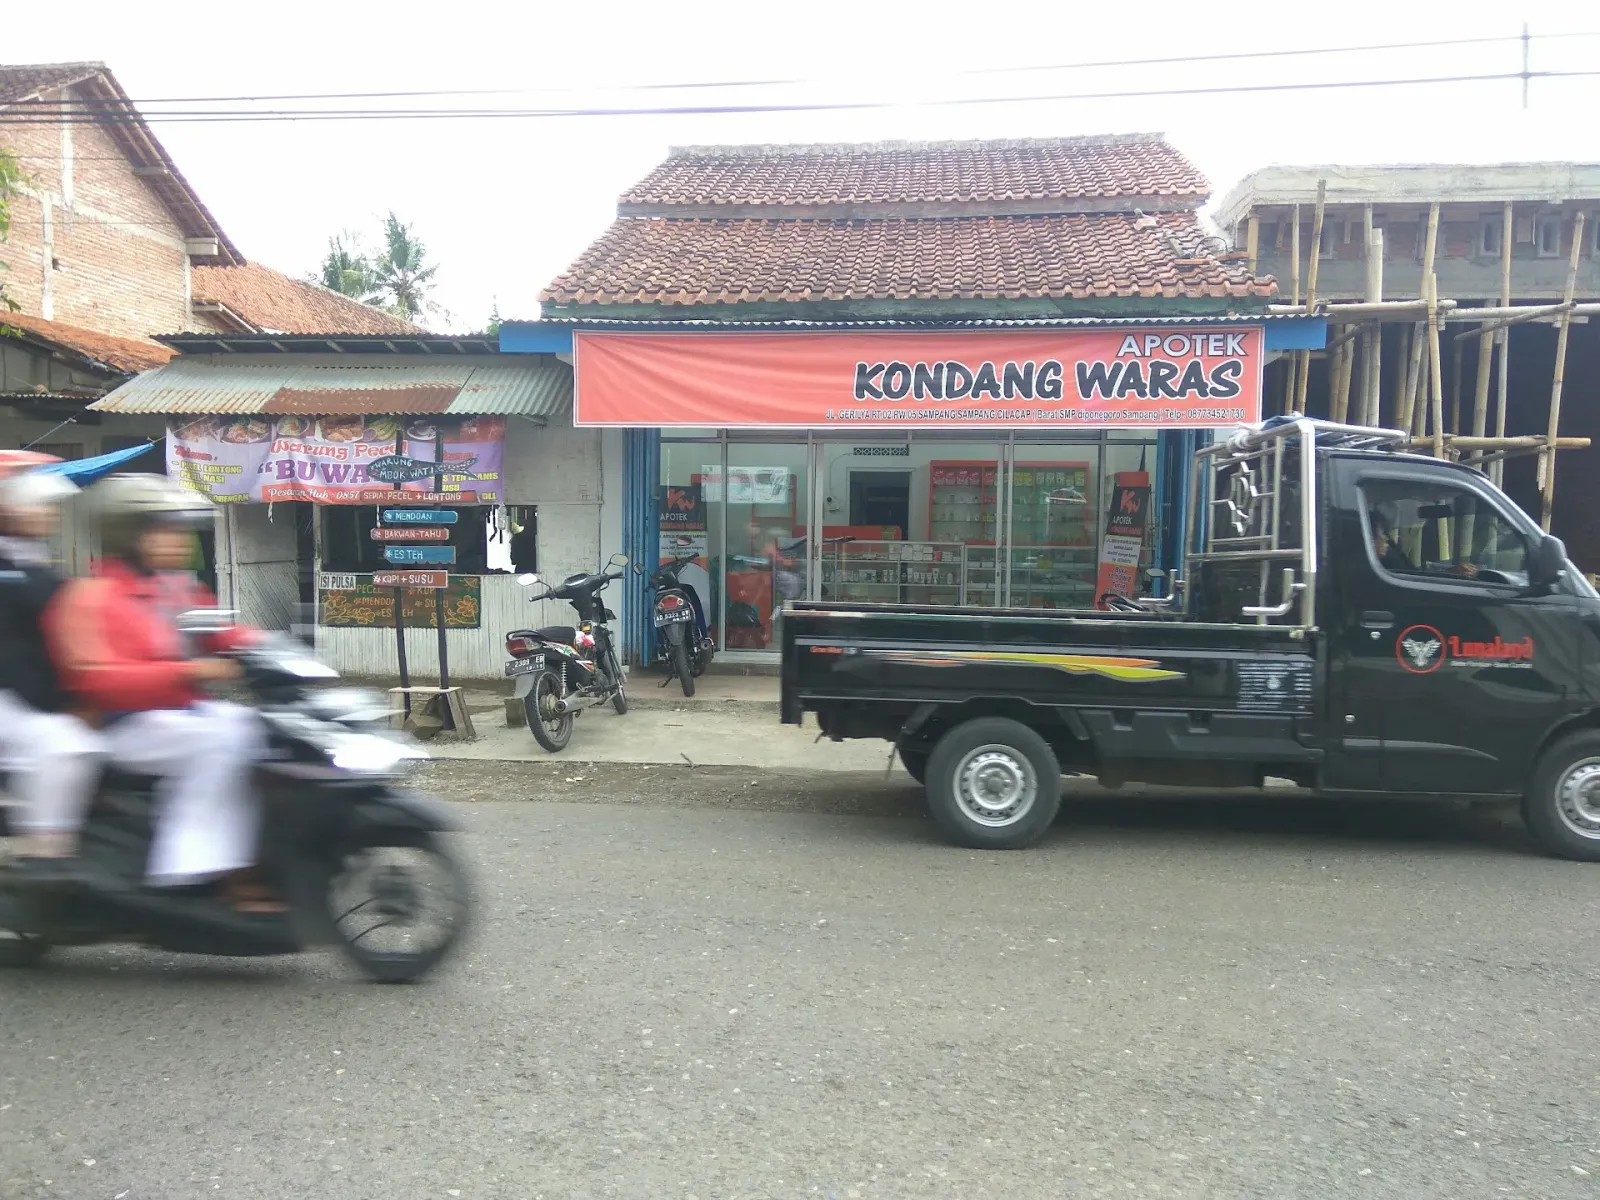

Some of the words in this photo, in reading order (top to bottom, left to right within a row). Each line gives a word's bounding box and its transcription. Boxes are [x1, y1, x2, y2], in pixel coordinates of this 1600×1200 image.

[1116, 333, 1250, 358] APOTEK
[853, 359, 1063, 401] KONDANG
[1074, 360, 1244, 401] WARAS
[839, 409, 870, 419] GERILYA
[918, 409, 956, 419] SAMPANG
[957, 410, 995, 419] SAMPANG
[996, 410, 1031, 419] CILACAP
[1059, 410, 1076, 419] SMP
[1122, 409, 1158, 421] Sampang
[270, 439, 349, 461] Warung
[374, 458, 414, 469] WARUNG
[203, 464, 243, 474] LONTONG
[203, 474, 225, 483] NASI
[387, 491, 413, 500] PECEL
[395, 512, 432, 521] MENDOAN
[660, 512, 688, 521] APOTEK
[384, 530, 441, 539] BAKWAN-TAHU
[394, 550, 405, 560] ES
[406, 550, 423, 559] TEH
[320, 576, 330, 588] ISI
[331, 576, 355, 588] PULSA
[408, 575, 434, 584] SUSU
[425, 598, 449, 607] SUU
